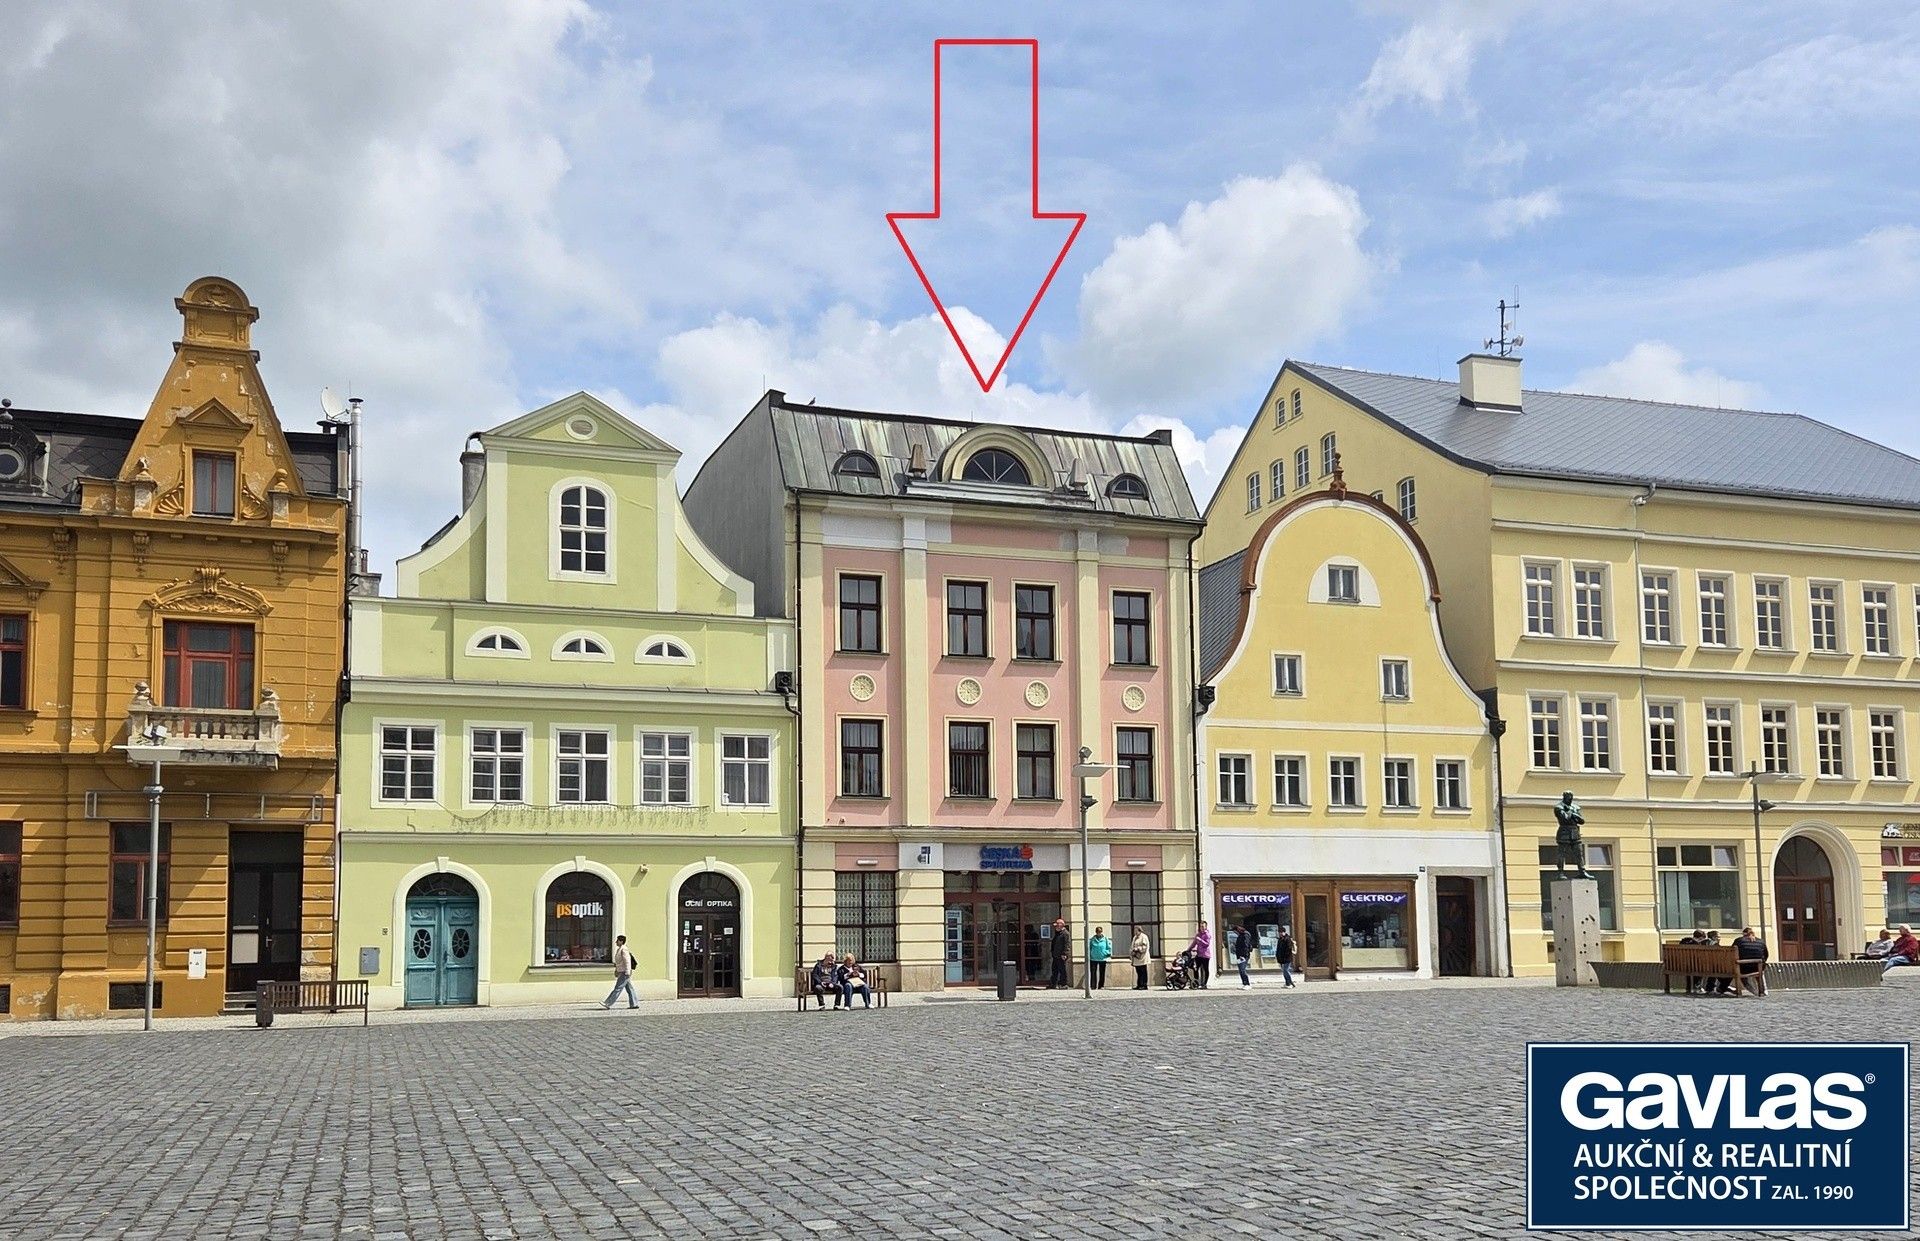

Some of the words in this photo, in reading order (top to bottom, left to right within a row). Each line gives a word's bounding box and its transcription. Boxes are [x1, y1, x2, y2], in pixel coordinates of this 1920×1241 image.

[1222, 895, 1277, 903] ELEKTRO
[1342, 894, 1394, 902] ELEKTRO
[556, 902, 604, 918] psoptik
